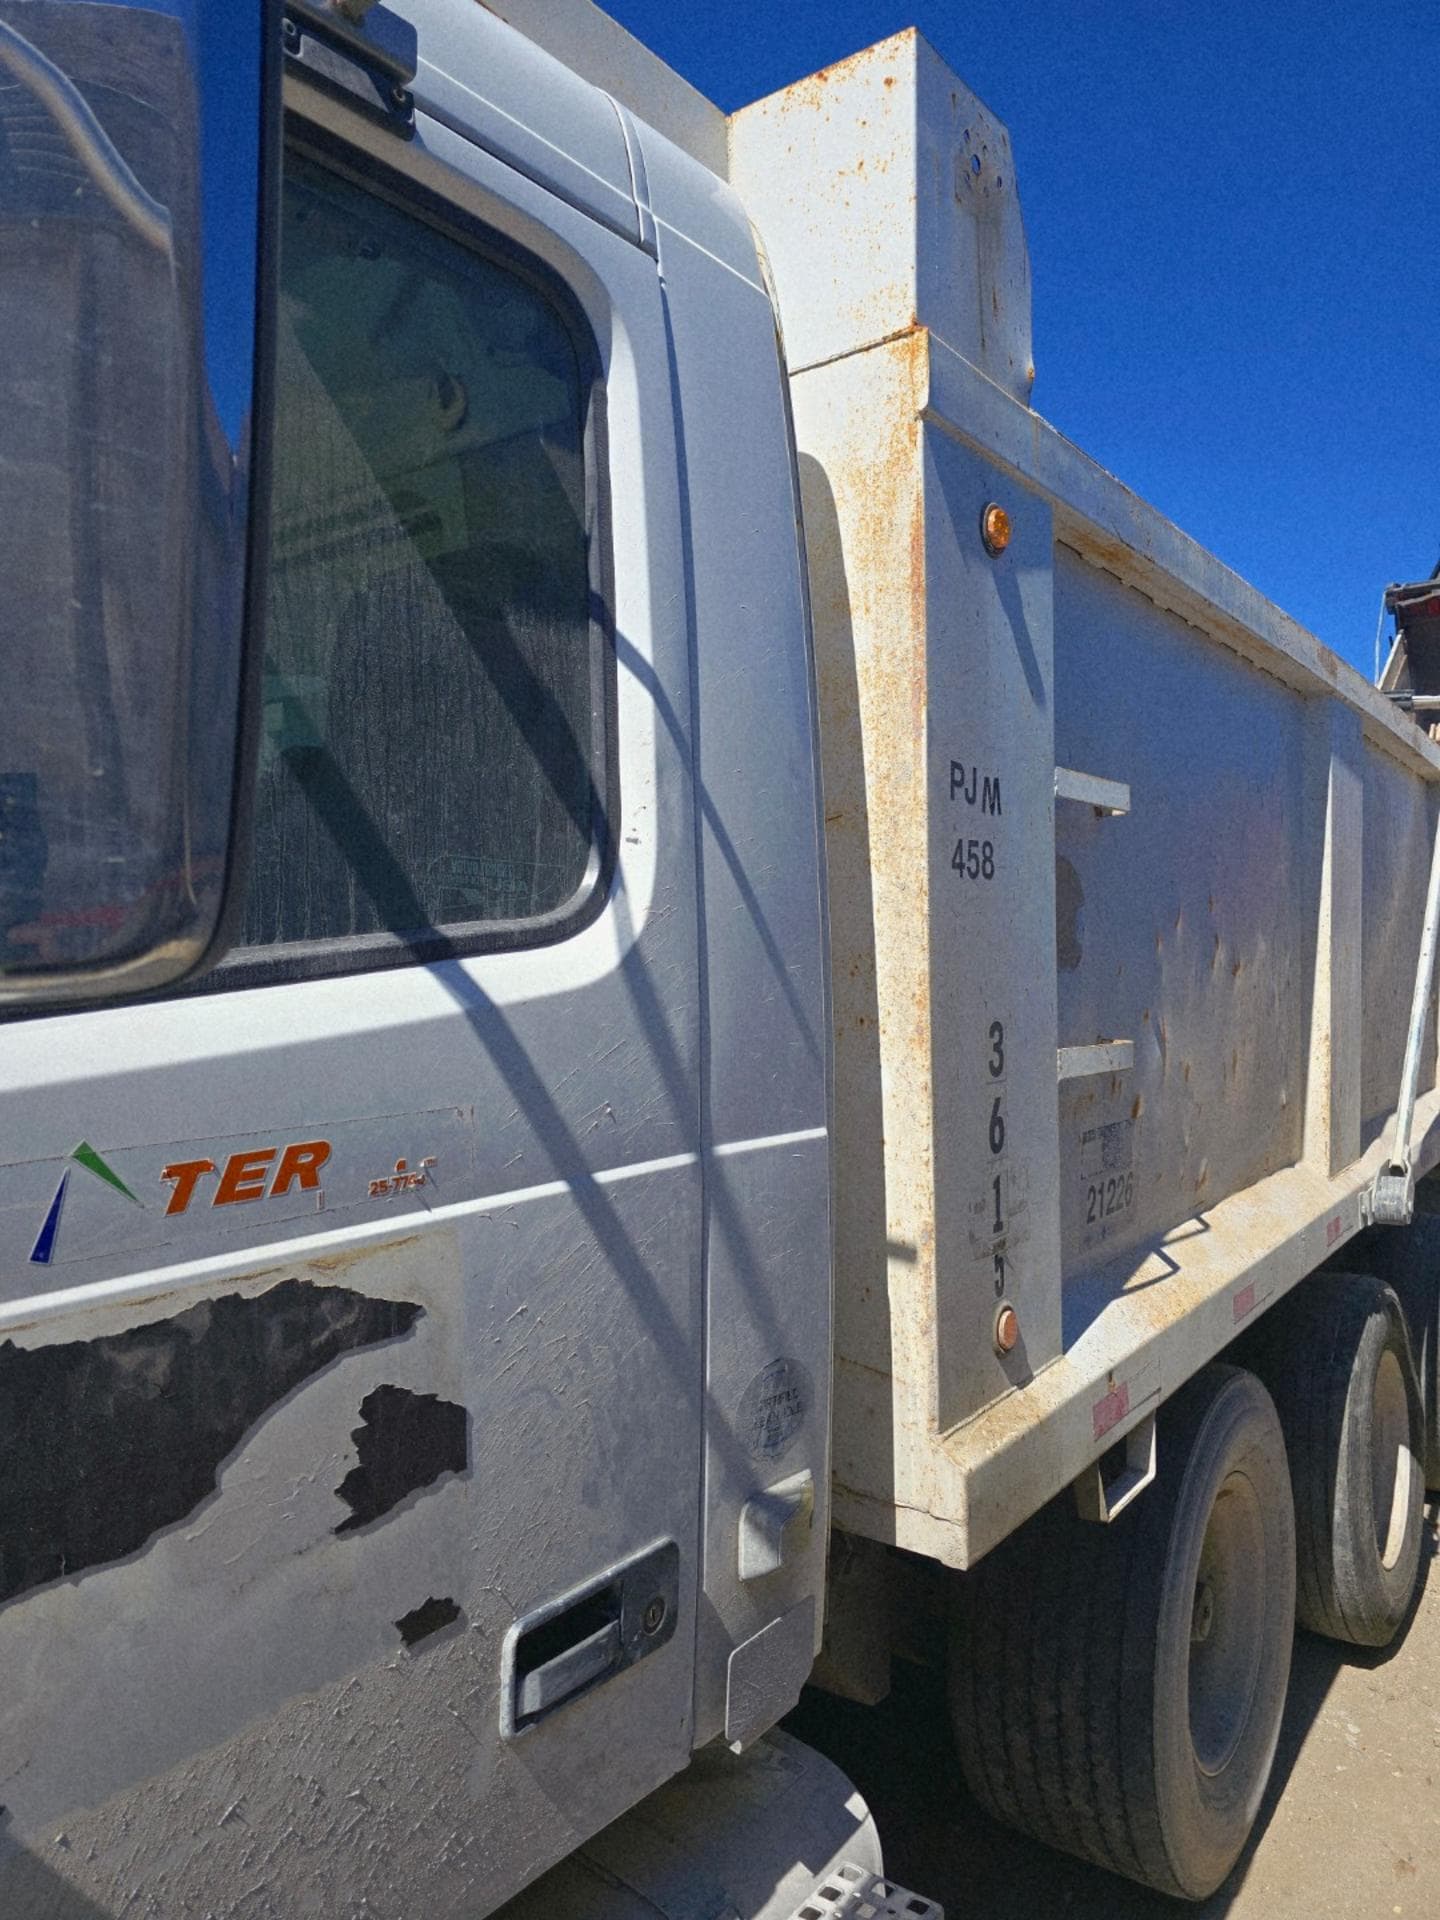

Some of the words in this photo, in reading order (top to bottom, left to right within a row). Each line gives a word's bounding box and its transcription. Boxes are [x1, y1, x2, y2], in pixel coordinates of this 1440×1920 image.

[950, 760, 1001, 816] PJM
[951, 838, 995, 880] 458
[159, 1139, 332, 1217] TER
